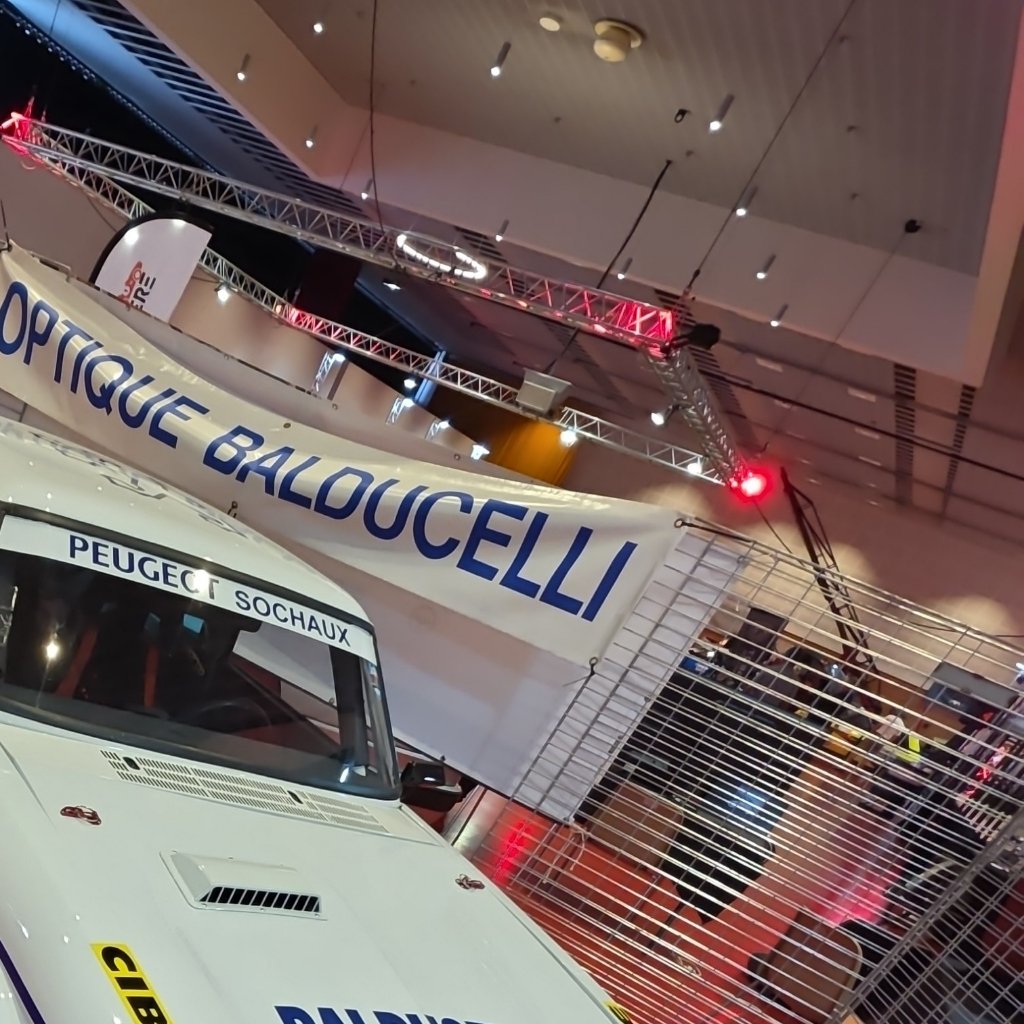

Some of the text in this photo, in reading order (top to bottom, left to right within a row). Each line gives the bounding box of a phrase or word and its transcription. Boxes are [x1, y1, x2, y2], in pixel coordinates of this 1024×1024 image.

[68, 534, 351, 648] PEUGEOT SOCHAUX
[202, 424, 638, 623] BALDUCELLI
